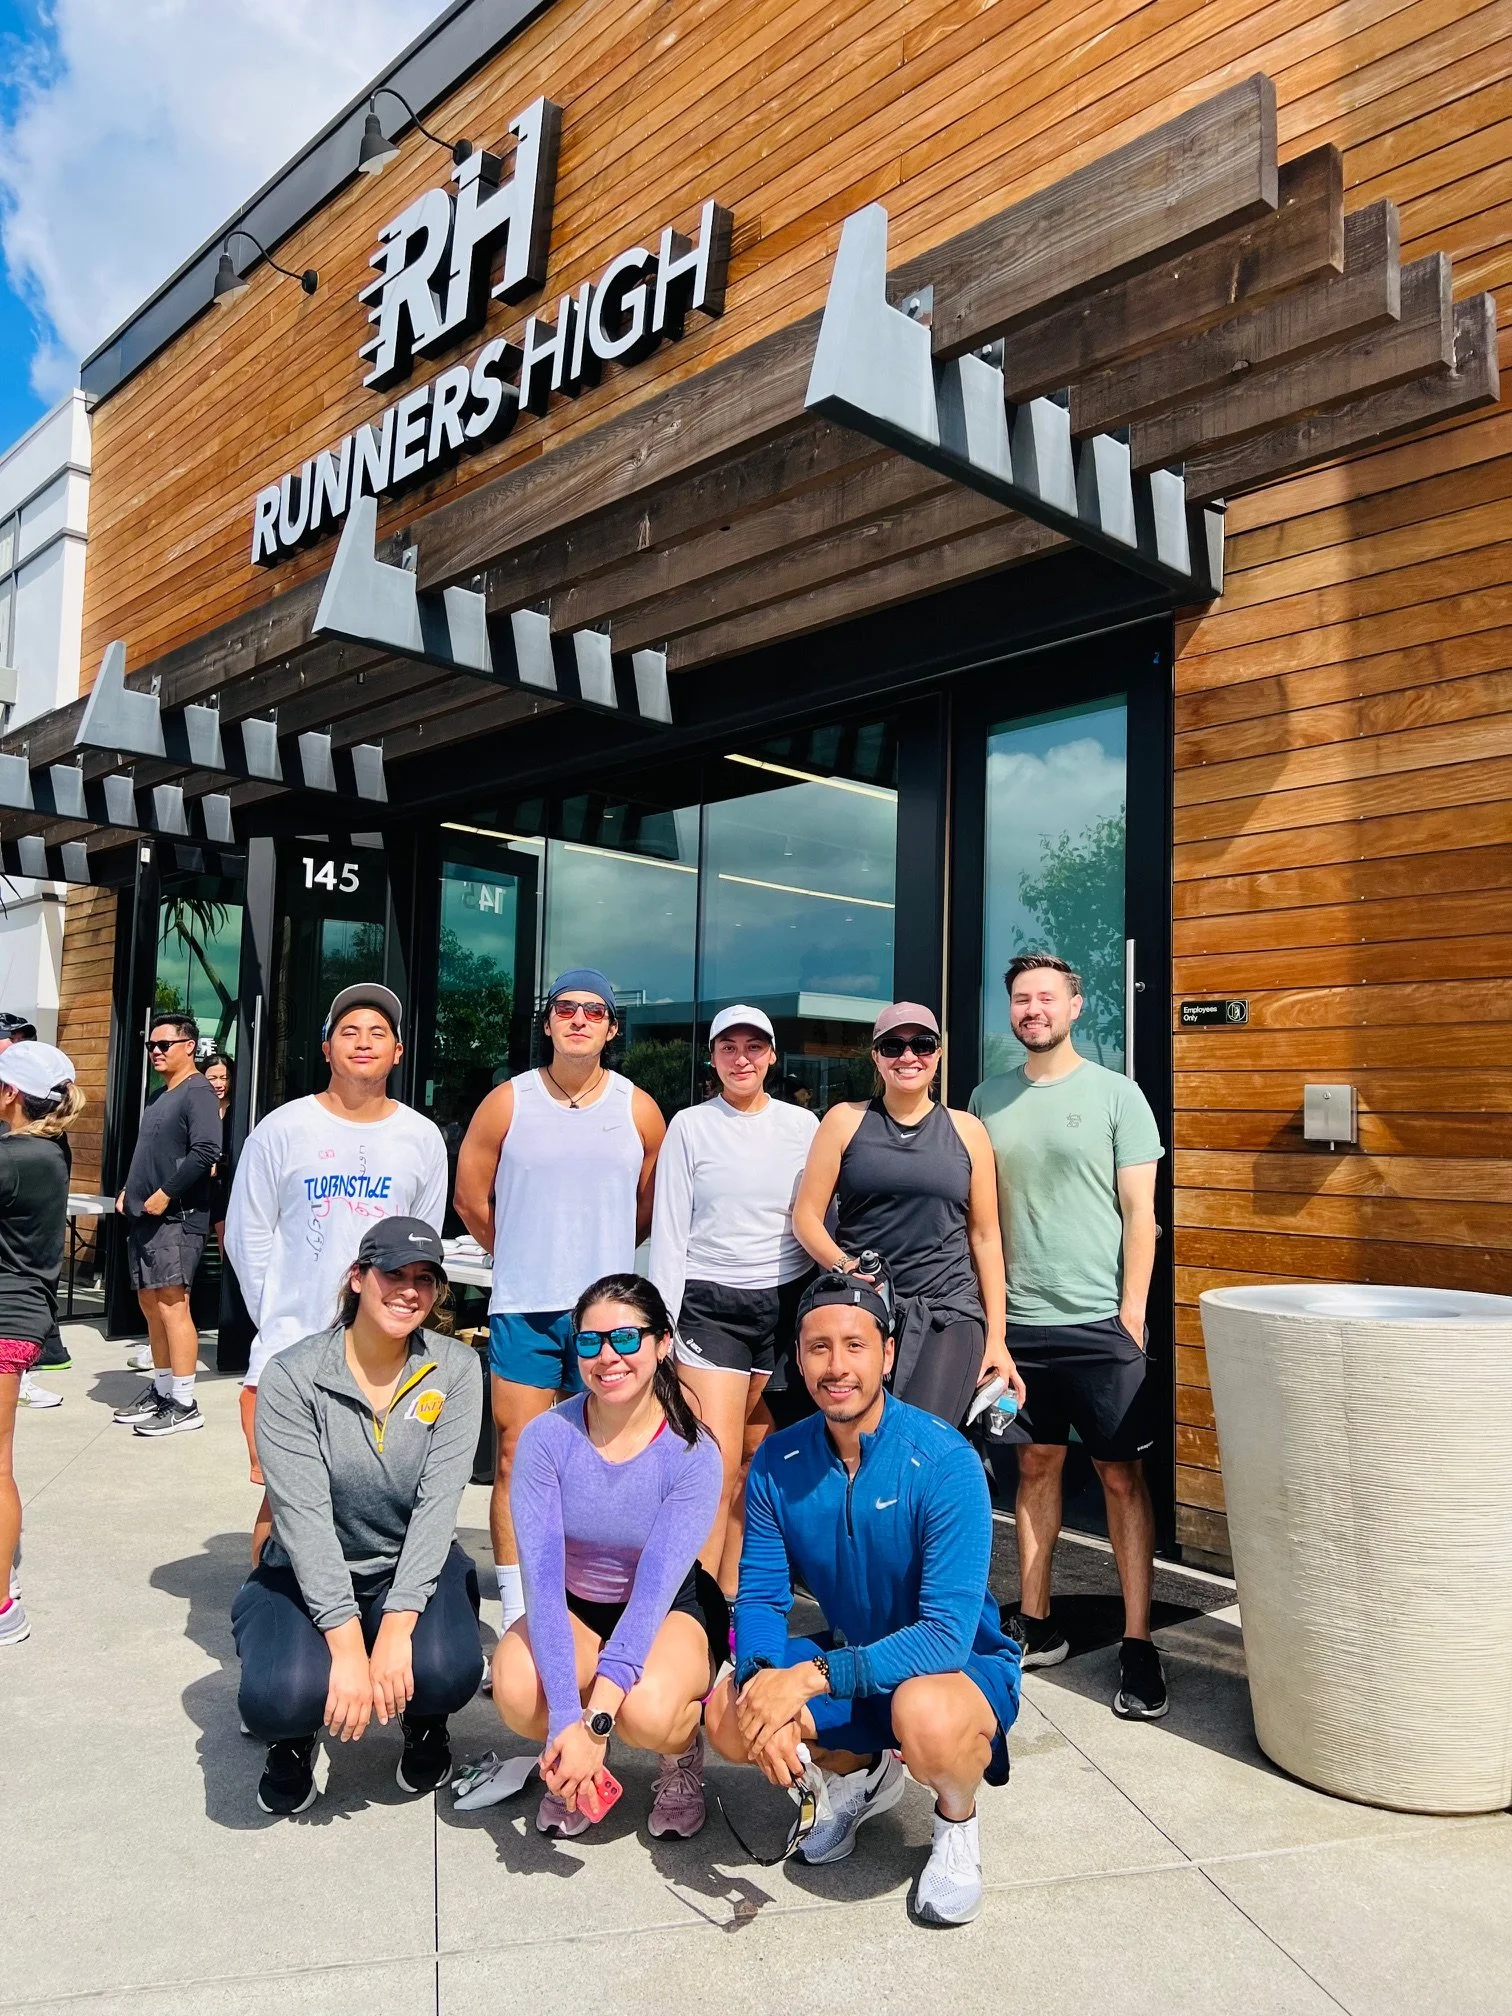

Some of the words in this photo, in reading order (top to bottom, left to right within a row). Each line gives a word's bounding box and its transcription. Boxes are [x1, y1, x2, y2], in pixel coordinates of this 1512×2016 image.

[359, 96, 548, 390] RH
[250, 338, 508, 566] RUNNERS
[518, 199, 717, 411] HIGH
[303, 857, 359, 893] 145
[1183, 1005, 1218, 1014] Employees
[1183, 1014, 1198, 1022] Only
[304, 1174, 392, 1201] TURNSTILE
